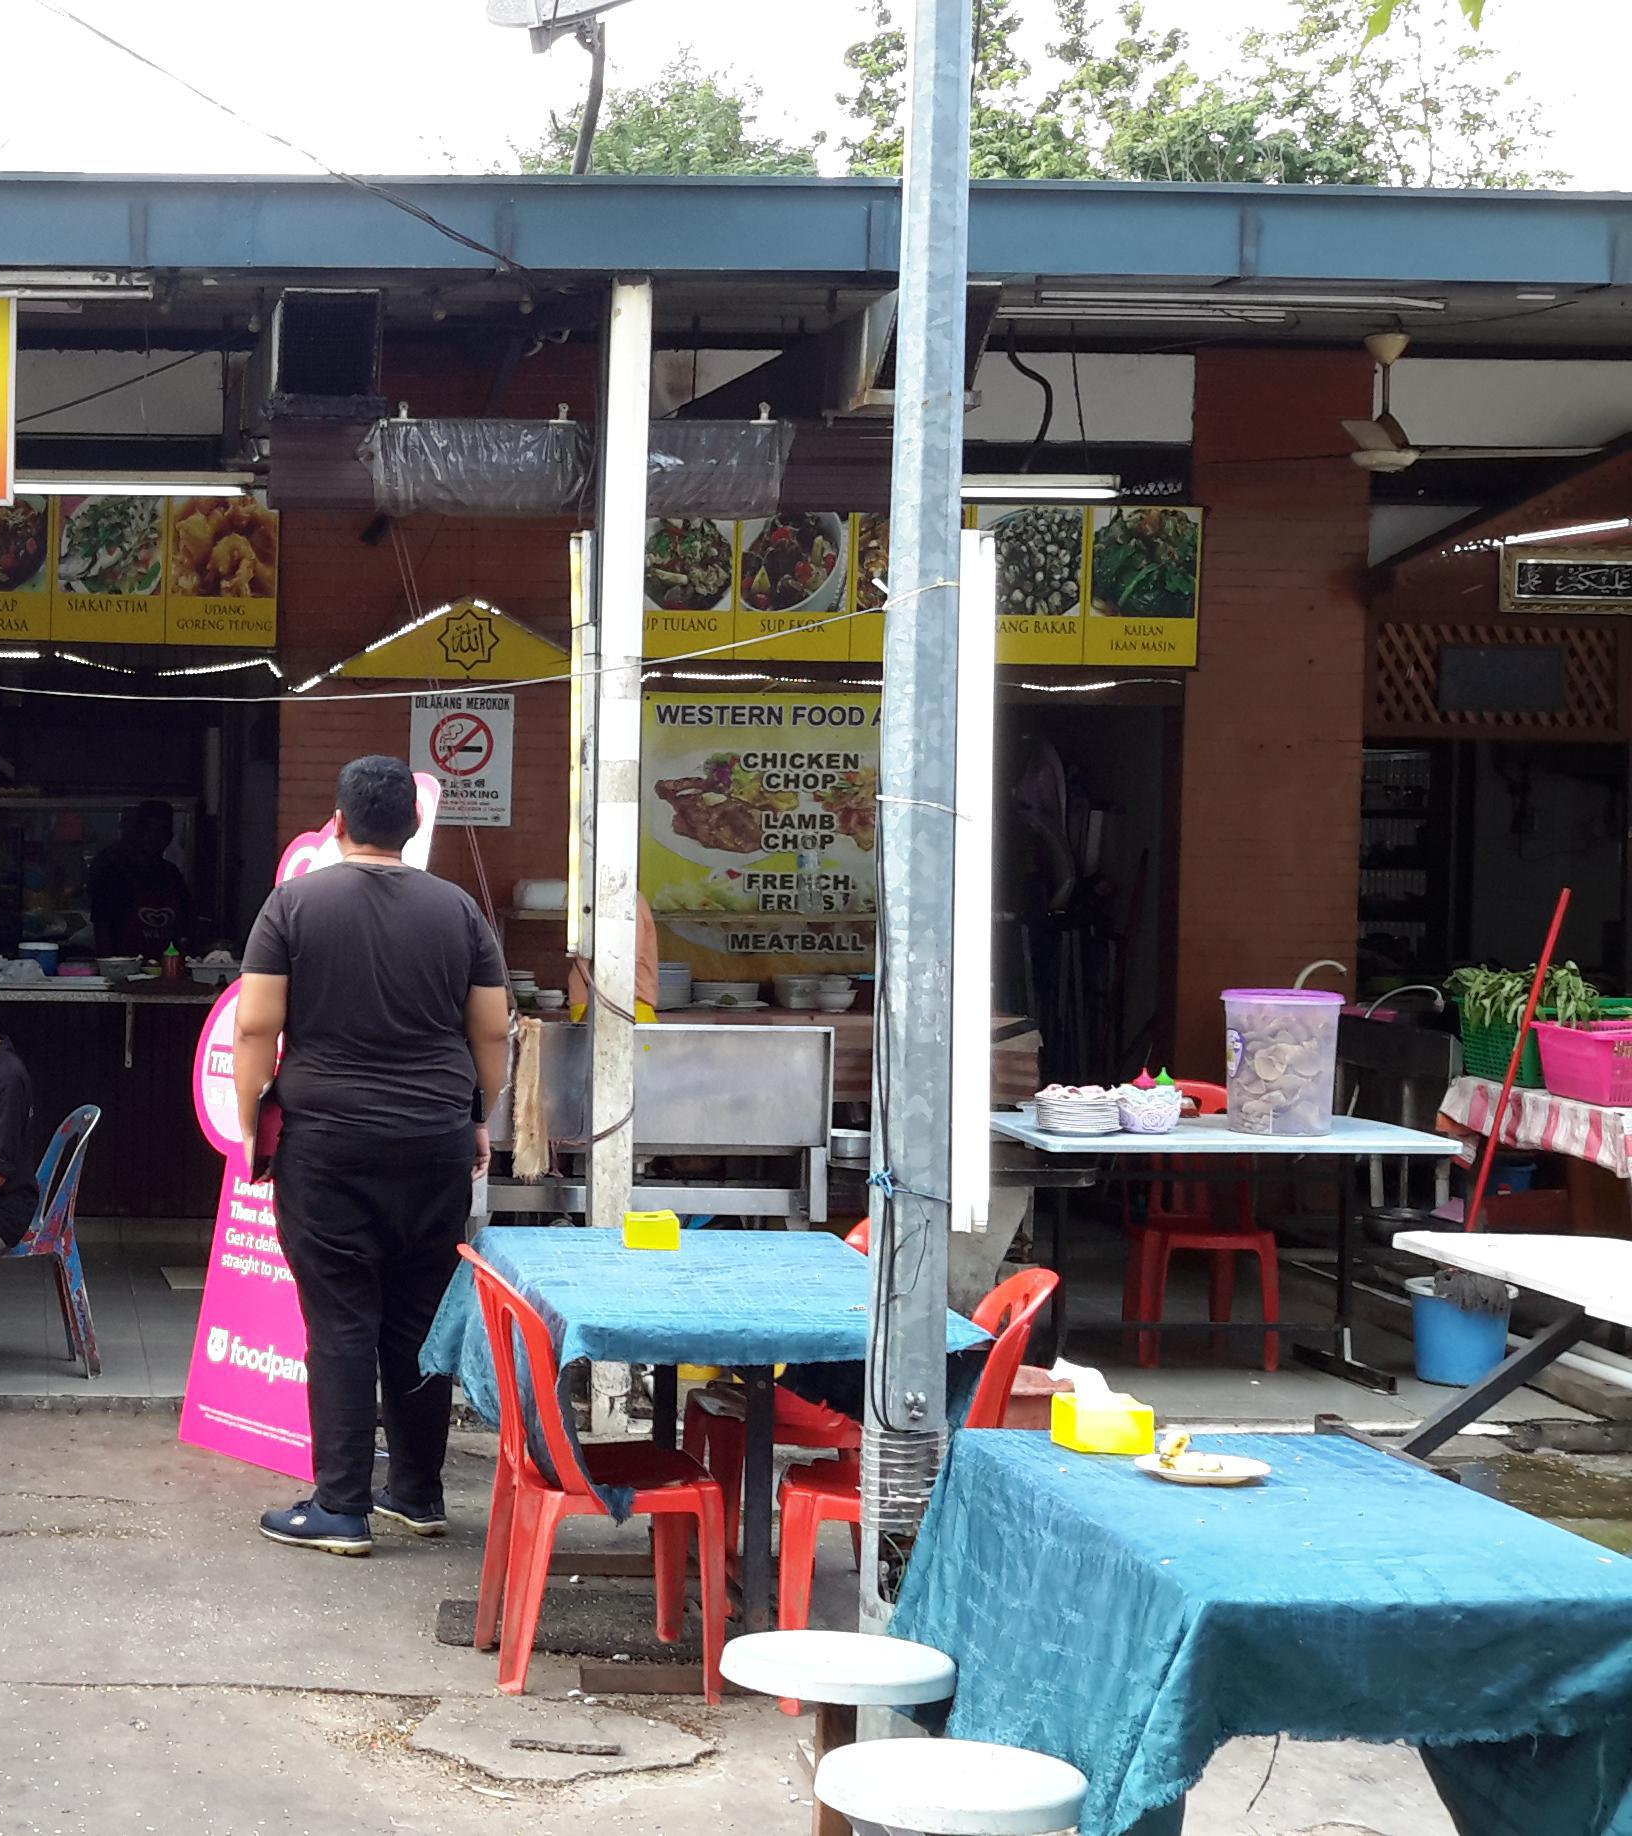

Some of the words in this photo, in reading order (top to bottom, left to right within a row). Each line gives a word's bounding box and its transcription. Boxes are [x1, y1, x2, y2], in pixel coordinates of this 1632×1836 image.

[67, 599, 112, 613] SIAKAP
[115, 600, 148, 613] STIM
[204, 604, 246, 616] UDANG
[176, 618, 225, 631] GORENG
[227, 619, 273, 632] TEPUNG
[663, 618, 718, 632] TULANG
[760, 619, 785, 633] SUP
[1034, 621, 1077, 635] BAKAR
[1124, 624, 1164, 636] KAILAN
[1110, 640, 1137, 651] IKAN
[1142, 641, 1176, 651] MASIN
[415, 696, 462, 709] DILARANG
[466, 697, 510, 710] MEROKOK
[656, 704, 783, 726] WESTERN
[791, 706, 866, 727] FOOD
[742, 752, 860, 770] CHICKEN
[764, 772, 836, 791] CHOP
[442, 790, 499, 799] SMOKING
[763, 813, 835, 831] LAMB
[762, 833, 834, 850] CHOP
[761, 894, 834, 911] FRIS
[729, 934, 865, 951] MEATBALL
[234, 1176, 268, 1199] Loved
[230, 1200, 257, 1222] Then
[226, 1227, 245, 1247] Get
[246, 1232, 254, 1248] it
[255, 1234, 283, 1254] deliv
[221, 1253, 260, 1275] straight
[261, 1261, 272, 1276] to
[230, 1336, 308, 1383] foodpan
